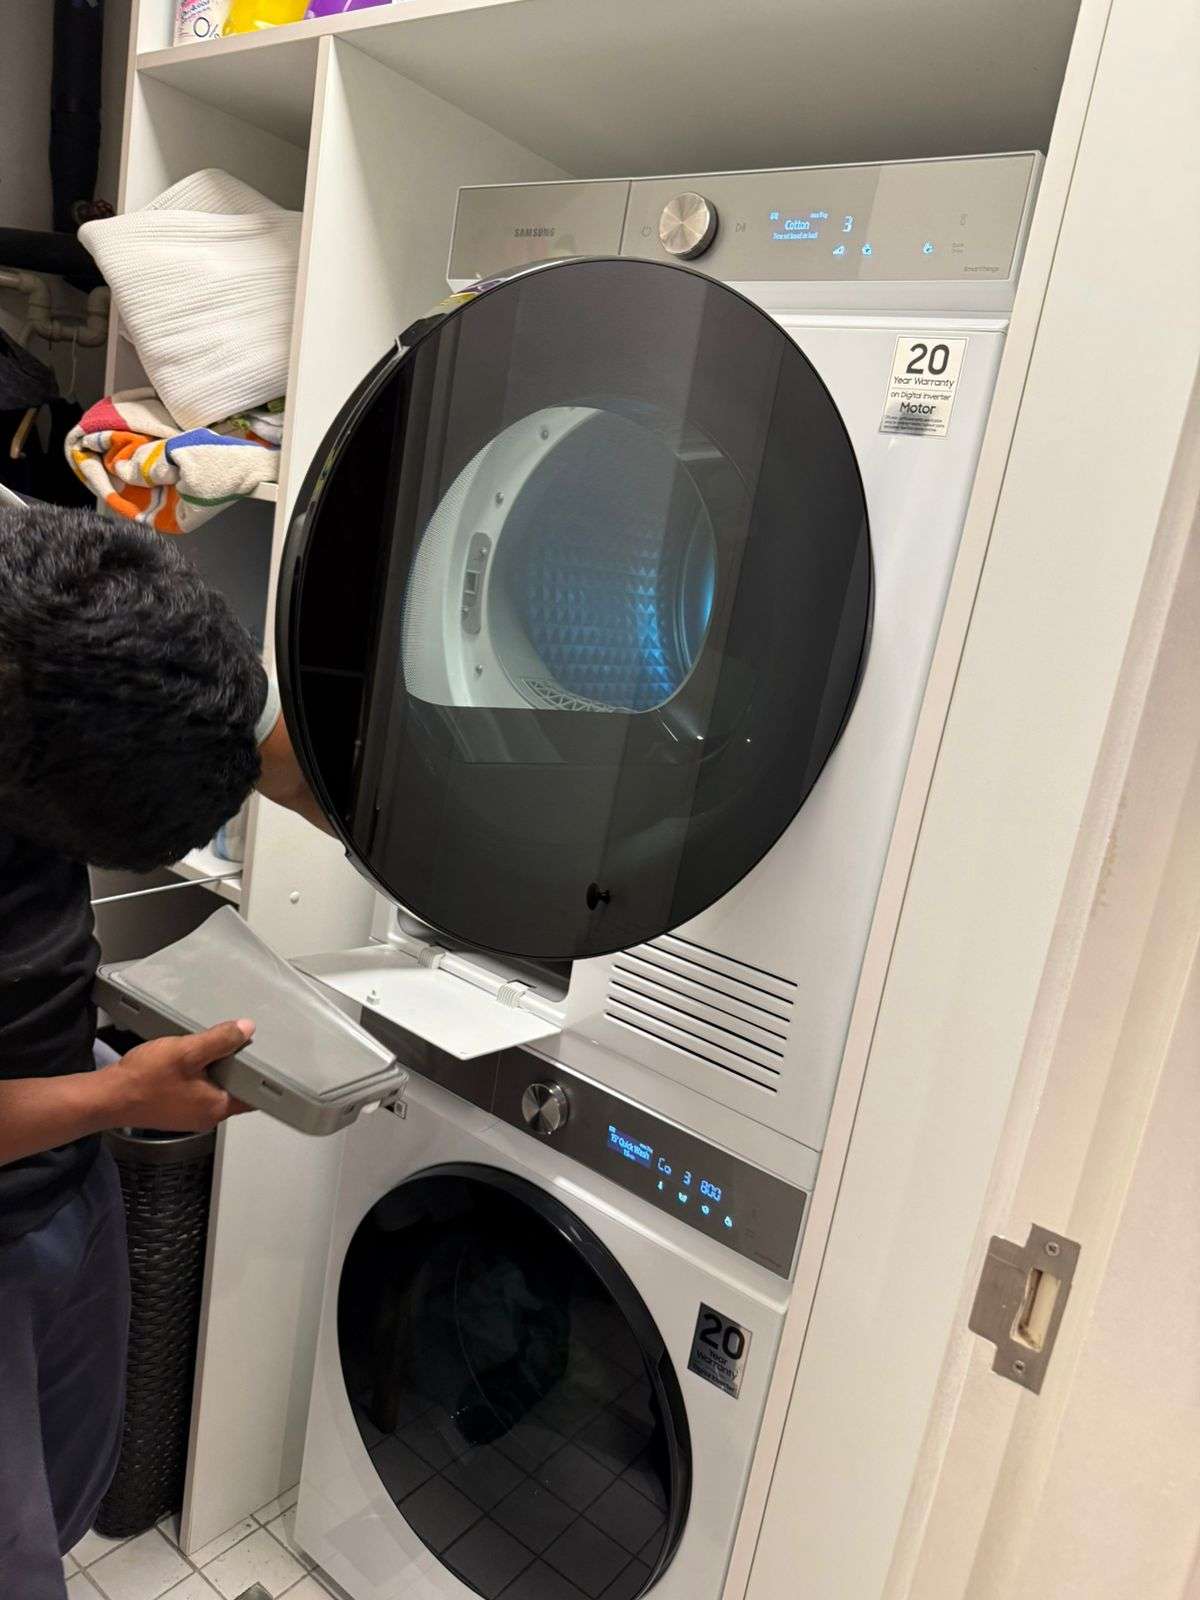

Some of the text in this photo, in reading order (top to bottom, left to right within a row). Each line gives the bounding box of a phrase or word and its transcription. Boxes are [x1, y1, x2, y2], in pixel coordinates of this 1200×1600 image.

[784, 219, 810, 230] Cotton
[842, 215, 853, 232] 3
[514, 228, 556, 238] SAMSUNG
[906, 343, 950, 375] 20
[894, 376, 955, 389] Year Warranty
[900, 391, 922, 400] Digital
[900, 401, 937, 414] Motor
[619, 1137, 634, 1152] Quick
[633, 1145, 650, 1160] Wash
[682, 1171, 692, 1186] 3
[699, 1313, 746, 1360] 20
